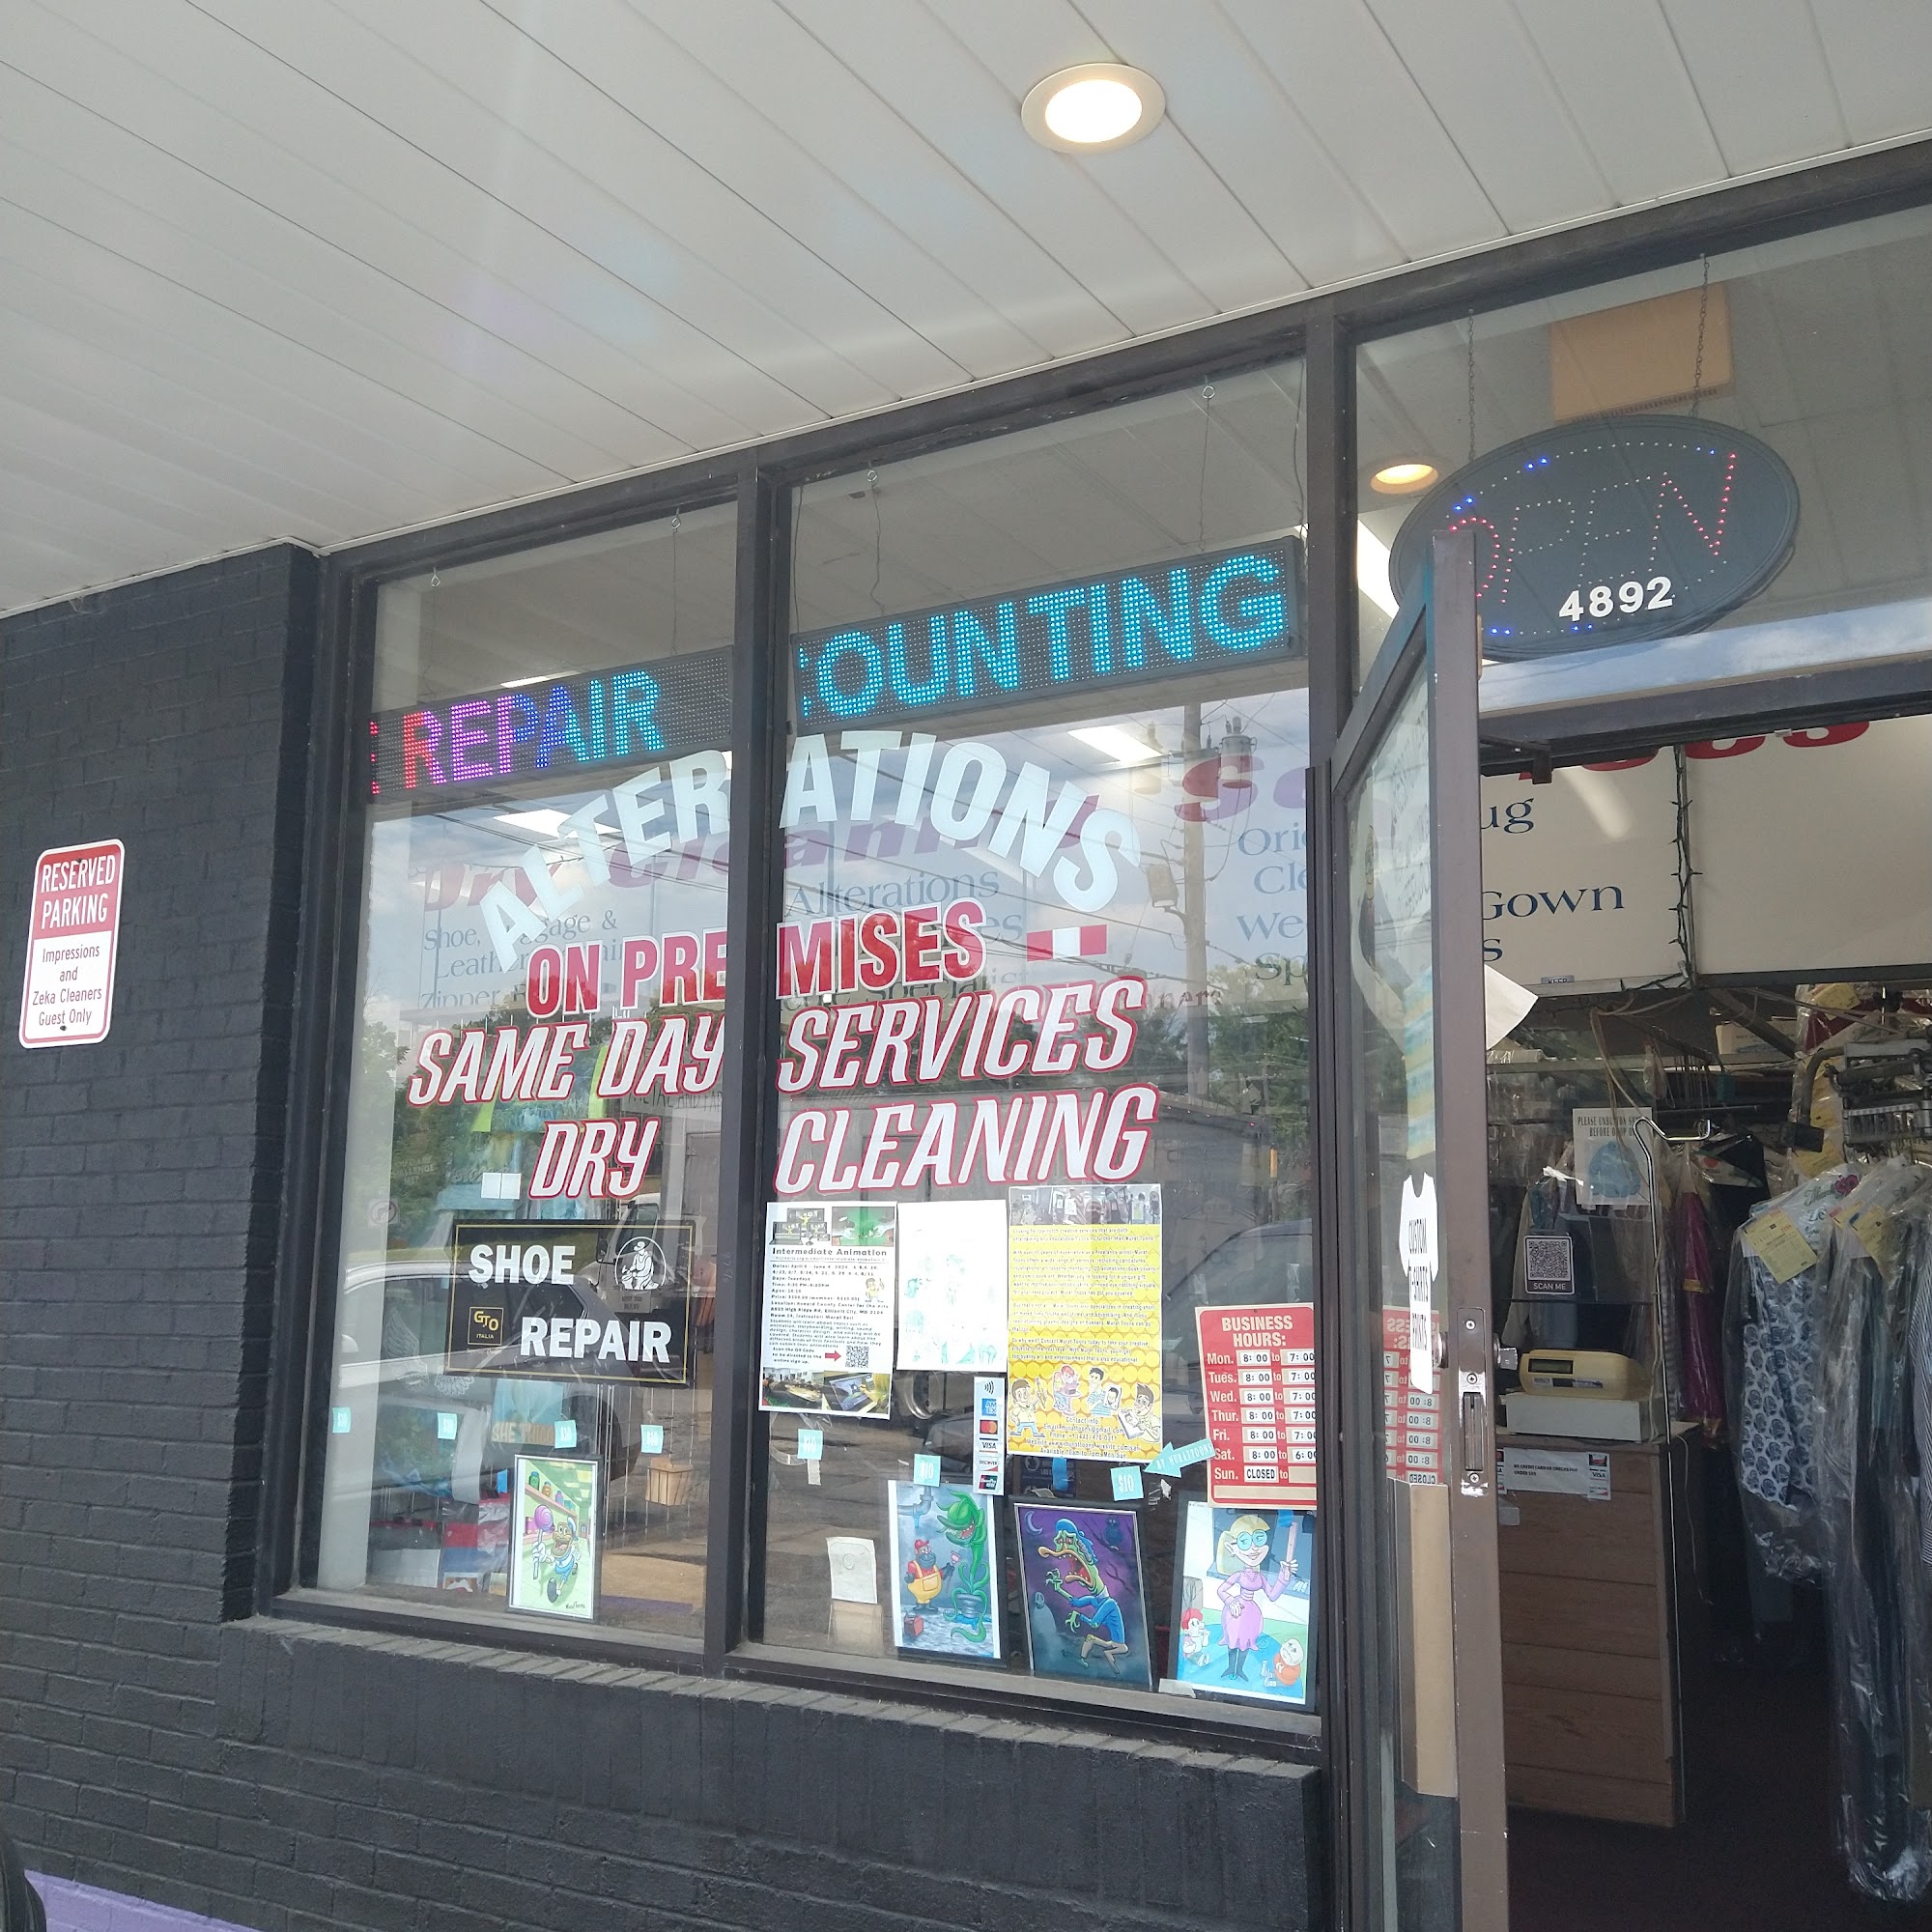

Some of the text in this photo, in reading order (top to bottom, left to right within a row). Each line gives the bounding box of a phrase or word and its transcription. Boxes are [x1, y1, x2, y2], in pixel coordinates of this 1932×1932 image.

[1558, 576, 1675, 622] 4892
[402, 670, 666, 789] REPAIR
[41, 854, 116, 893] RESERVED
[784, 870, 1001, 917] Alterations
[41, 893, 108, 930] PARKING
[42, 943, 100, 965] Impressions
[59, 966, 78, 982] and
[526, 939, 603, 1018] ON
[32, 986, 102, 1006] Zeka Cleaners
[39, 1009, 93, 1027] Guest Only
[407, 1022, 590, 1108] SAME
[596, 1012, 726, 1099] DAY
[776, 976, 1148, 1094] SERVICES
[528, 1083, 1160, 1200] DRY CLEANING
[837, 1248, 887, 1257] Animation
[468, 1243, 577, 1285] SHOE
[1533, 1282, 1553, 1291] SCAN
[473, 1310, 499, 1332] GTO
[1222, 1316, 1293, 1332] BUSINESS
[520, 1316, 673, 1364] REPAIR
[1233, 1332, 1287, 1348] HOURS:
[1207, 1352, 1235, 1365] Mon.
[1271, 1352, 1281, 1362] to
[1208, 1372, 1237, 1384] Tues.
[1273, 1372, 1282, 1381] to
[1209, 1391, 1237, 1403] Wed.
[1274, 1391, 1284, 1401] to
[1211, 1409, 1239, 1422] Thur.
[1276, 1410, 1285, 1420] to
[1212, 1429, 1231, 1441] Fri.
[1277, 1431, 1286, 1440] to
[1213, 1448, 1236, 1461] Sat.
[1278, 1450, 1288, 1460] to
[1214, 1467, 1289, 1480] Sun. CLOSED to
[1118, 1474, 1135, 1493] $10
